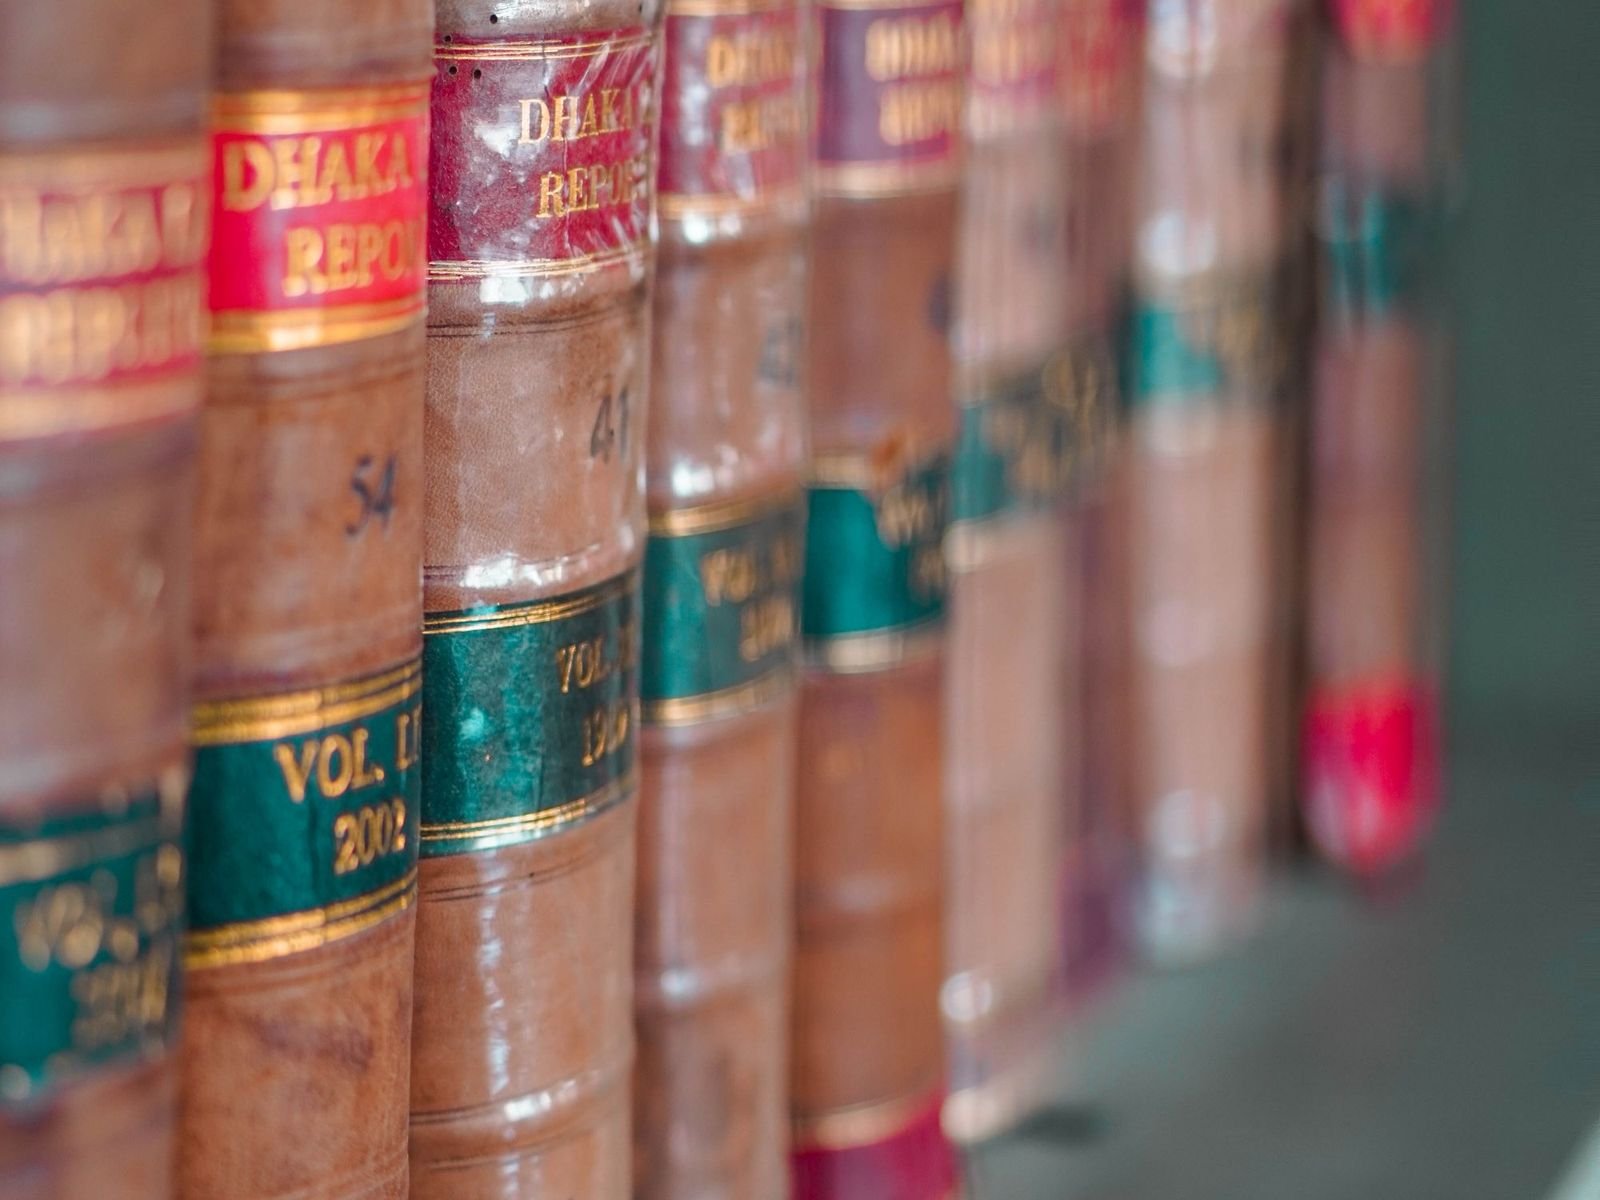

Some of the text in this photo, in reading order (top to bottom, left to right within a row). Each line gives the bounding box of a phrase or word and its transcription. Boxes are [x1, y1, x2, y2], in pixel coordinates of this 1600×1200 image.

[222, 131, 413, 213] DHAKA
[344, 455, 397, 543] 54
[333, 798, 406, 876] 2002
